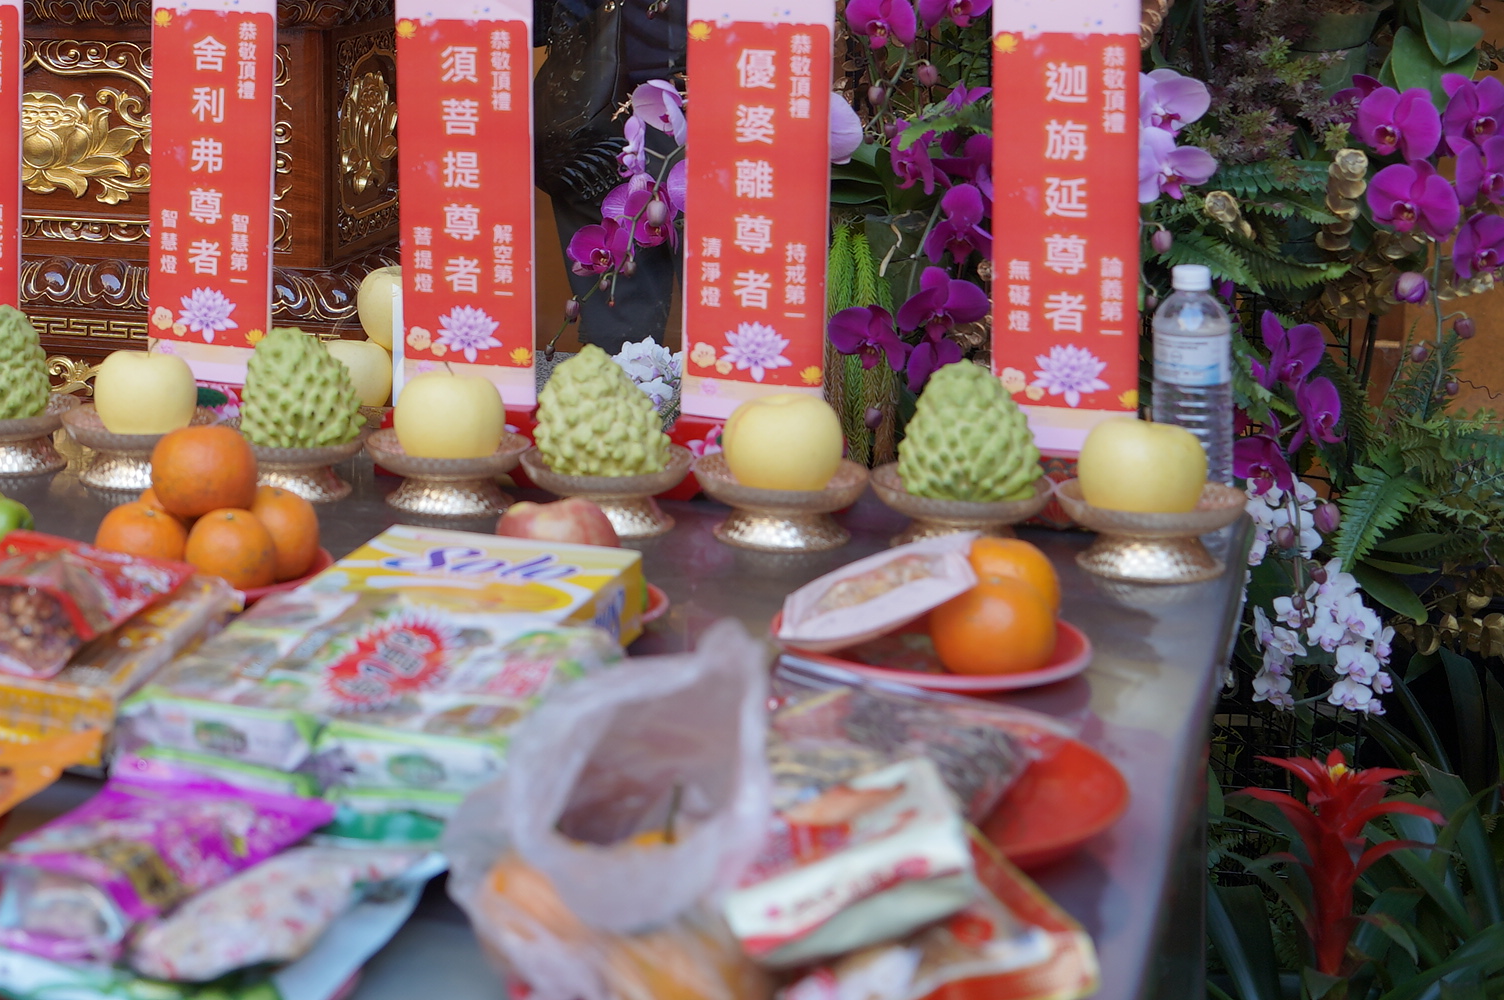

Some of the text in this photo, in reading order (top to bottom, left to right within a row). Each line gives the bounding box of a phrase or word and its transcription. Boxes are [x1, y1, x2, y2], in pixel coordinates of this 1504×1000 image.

[237, 22, 258, 100] 恭敬頂禮
[490, 30, 512, 112] 恭敬頂禮
[788, 34, 812, 120] 恭敬頂禮
[1102, 46, 1126, 134] 恭敬頂禮
[188, 36, 227, 276] 舍利弗尊者
[440, 45, 482, 294] 須菩提尊者
[733, 48, 777, 311] 優婆離尊者
[160, 208, 178, 275] 智慧燈
[230, 214, 249, 285] 智慧第一
[412, 226, 434, 294] 菩提燈
[492, 224, 514, 298] 解空第一
[700, 236, 722, 308] 清淨燈
[784, 243, 806, 320] 持戒第一
